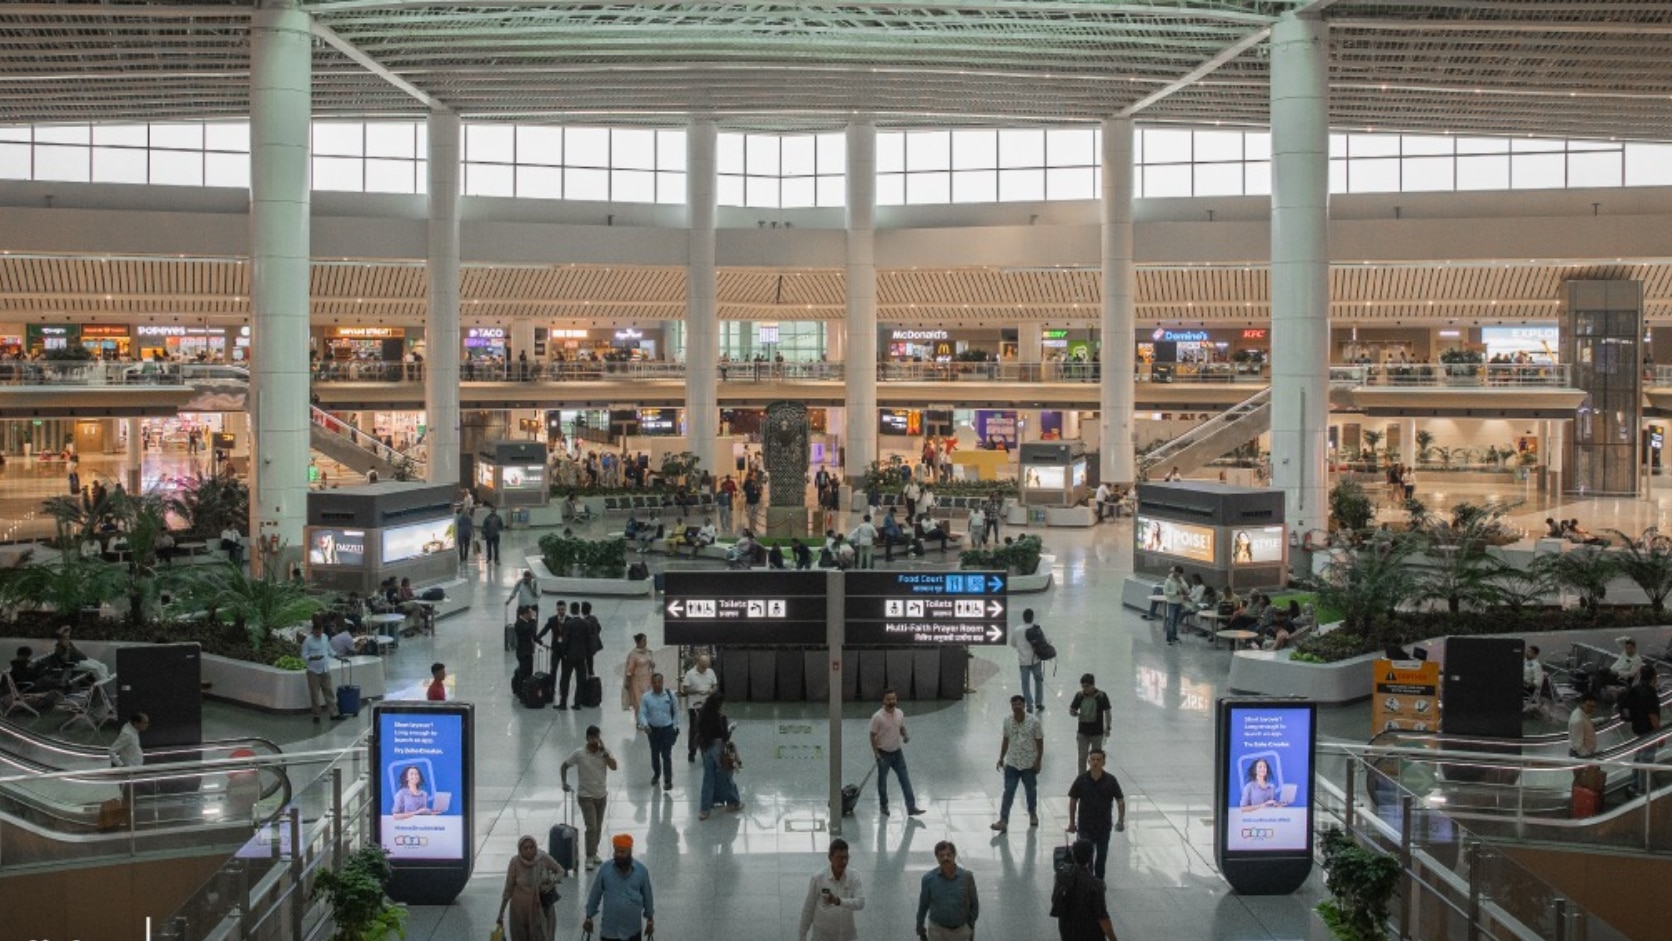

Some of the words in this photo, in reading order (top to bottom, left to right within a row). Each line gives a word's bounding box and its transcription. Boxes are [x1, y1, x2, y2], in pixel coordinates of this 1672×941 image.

[137, 326, 186, 336] POPEYES
[478, 328, 504, 337] TACO
[892, 329, 948, 339] McDonald's
[1165, 331, 1208, 340] Domino's
[1243, 330, 1265, 338] KFC
[898, 575, 919, 583] Food
[921, 575, 943, 583] Court
[718, 600, 747, 608] Toilets
[925, 600, 952, 608] Toilets
[886, 624, 932, 632] Multi-Faith
[933, 624, 958, 634] Prayer
[960, 625, 984, 633] Room
